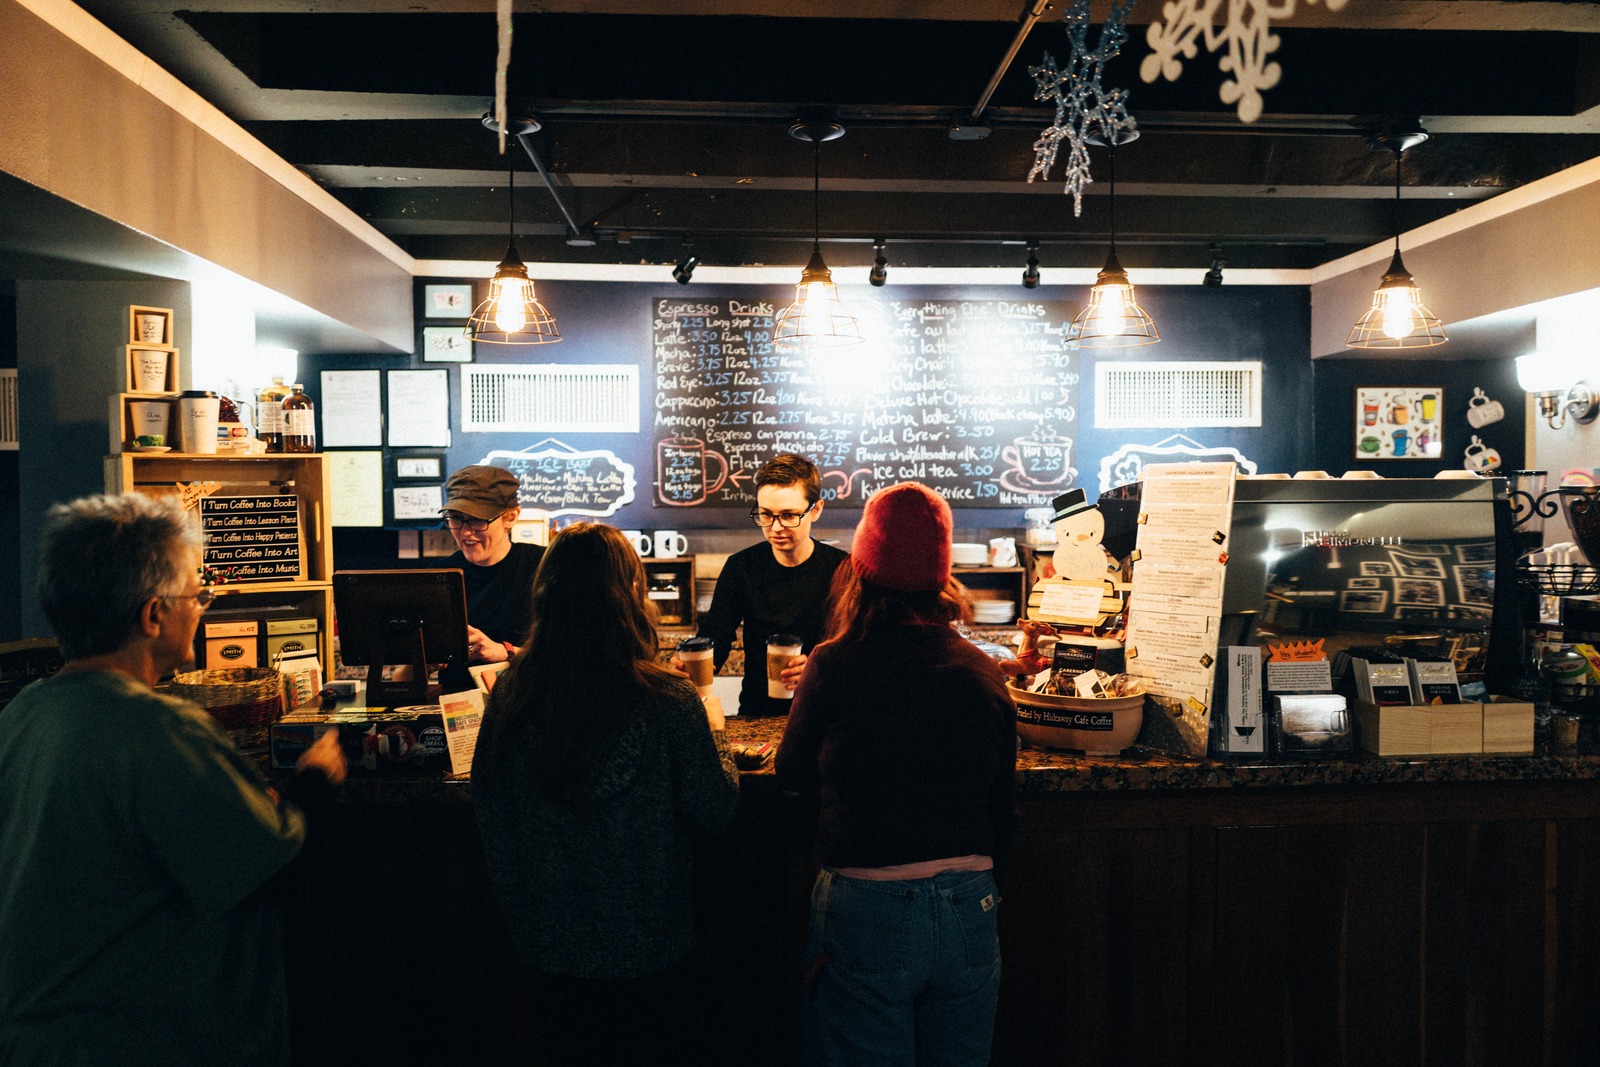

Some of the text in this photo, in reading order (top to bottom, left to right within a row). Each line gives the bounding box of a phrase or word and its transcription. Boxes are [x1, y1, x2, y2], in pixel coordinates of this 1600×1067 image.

[658, 300, 774, 320] Espresso Drinks
[998, 302, 1046, 317] Drinks
[682, 317, 704, 328] 2.25
[752, 317, 774, 328] 2.75
[691, 331, 718, 343] 3.50
[721, 332, 743, 342] 12oz
[744, 330, 769, 344] 4.00
[698, 345, 720, 357] 3.75
[722, 344, 747, 356] 12oz
[747, 343, 772, 355] 4.25
[697, 358, 723, 371] 3.75
[726, 356, 750, 369] 12oz
[749, 356, 779, 370] 4.25
[1036, 353, 1070, 368] 5.90
[657, 376, 677, 390] Red
[704, 372, 732, 387] 3.25
[733, 371, 761, 385] 12oz
[761, 371, 791, 384] 3.75
[720, 390, 752, 406] 3.25
[752, 388, 777, 405] 12oz
[917, 391, 943, 406] Hot
[720, 411, 752, 425] 2.25
[752, 411, 778, 424] 12oz
[778, 411, 805, 424] 2.75
[862, 410, 919, 429] Matcha
[706, 428, 752, 445] Espresso
[818, 428, 853, 441] 2.75
[860, 429, 898, 445] Cold
[954, 425, 994, 437] 3.50
[724, 443, 767, 459] Espresso
[825, 442, 853, 455] 2.75
[856, 447, 887, 462] Flavor
[1023, 446, 1063, 457] HOT TEA
[536, 458, 562, 470] ICE
[566, 457, 593, 470] BABY
[671, 457, 695, 467] 2.25
[730, 454, 763, 471] Flat
[1031, 458, 1062, 471] 2.25
[873, 463, 993, 479] ice cold tea 3.00
[973, 480, 999, 497] 7.50
[203, 498, 296, 510] I Turn Coffee Into Books
[207, 517, 223, 527] Turn
[224, 516, 243, 526] Coffee
[244, 516, 257, 525] Into
[258, 515, 279, 525] Lesson
[280, 515, 297, 524] Plans
[207, 531, 297, 543] Turn Coffee Into Happy Patients
[204, 547, 299, 560] I Turn Coffee Into Art
[232, 565, 261, 577] Coffee
[261, 564, 274, 574] Into
[275, 563, 299, 573] Music
[1057, 651, 1092, 660] GHIRARDELLI
[1280, 650, 1291, 660] Hey
[1058, 667, 1087, 675] CABERNET
[1033, 710, 1041, 722] by
[1043, 711, 1073, 726] Hideaway
[1074, 714, 1089, 725] Cafe
[1090, 715, 1112, 726] Coffee
